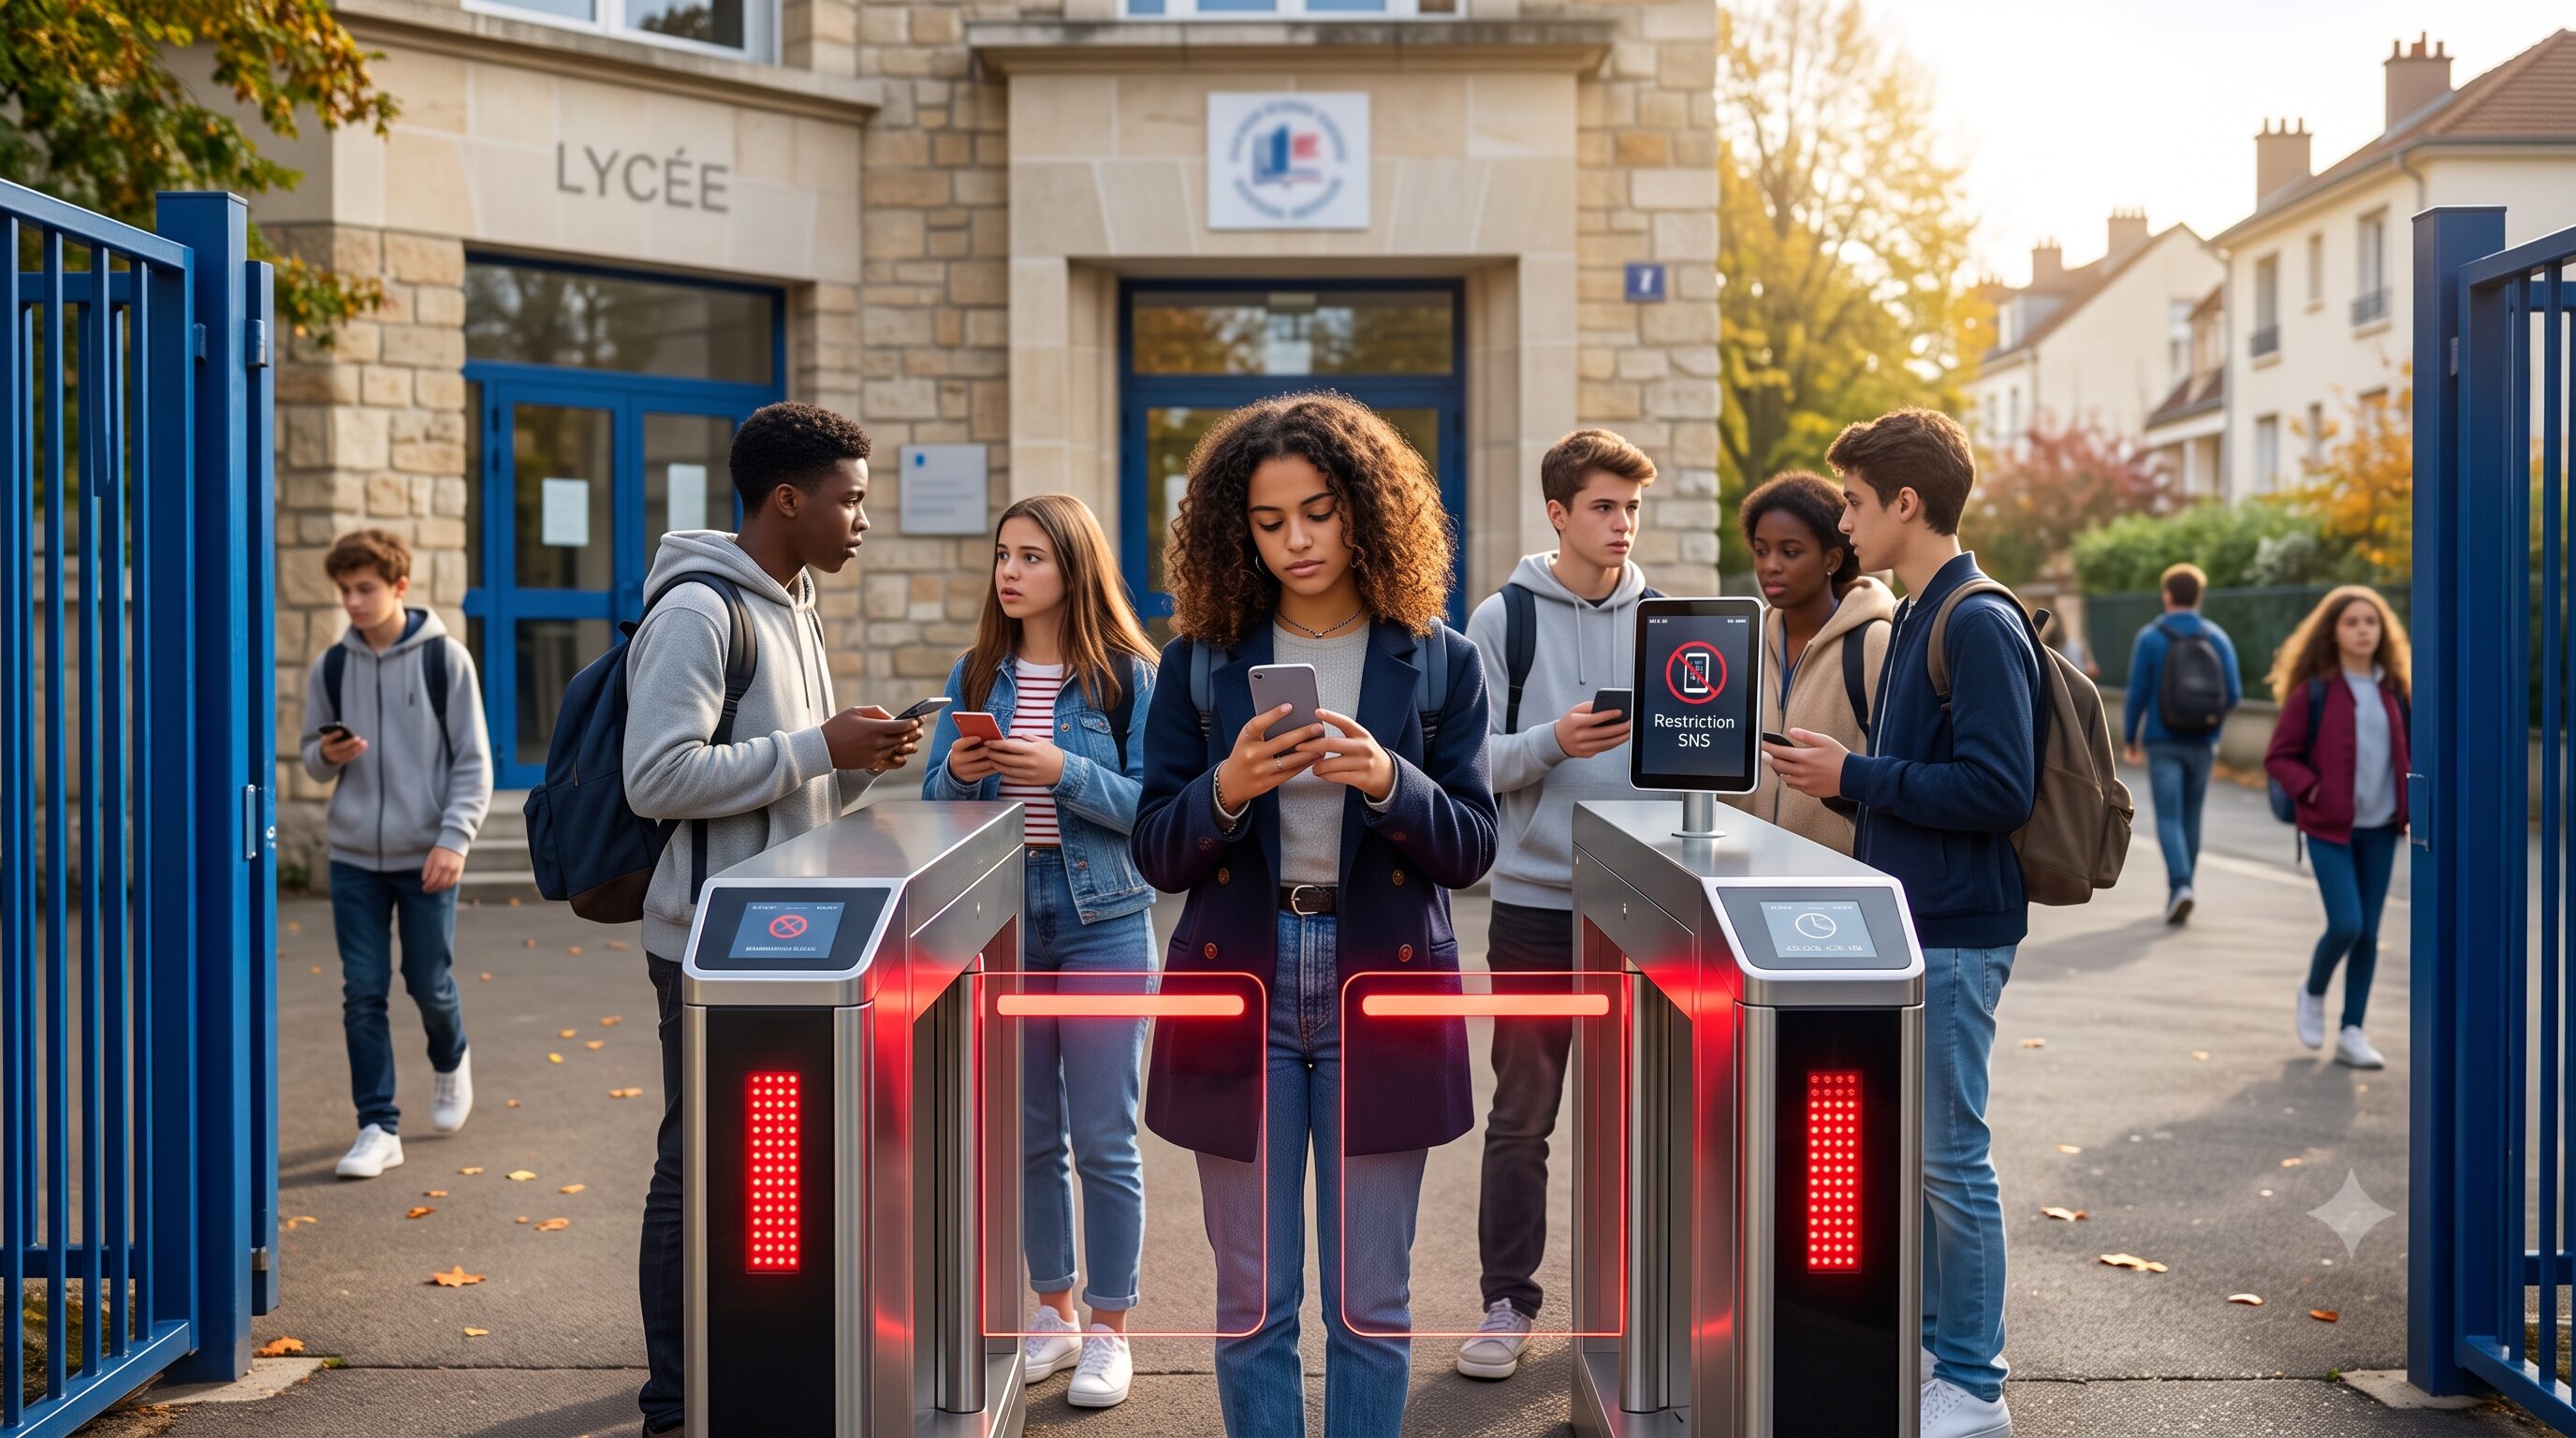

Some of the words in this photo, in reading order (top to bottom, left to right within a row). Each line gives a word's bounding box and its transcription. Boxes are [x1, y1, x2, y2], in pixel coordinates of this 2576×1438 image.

[557, 141, 729, 213] LYCÉE
[1654, 713, 1734, 728] Restriction
[1678, 733, 1710, 747] SNS
